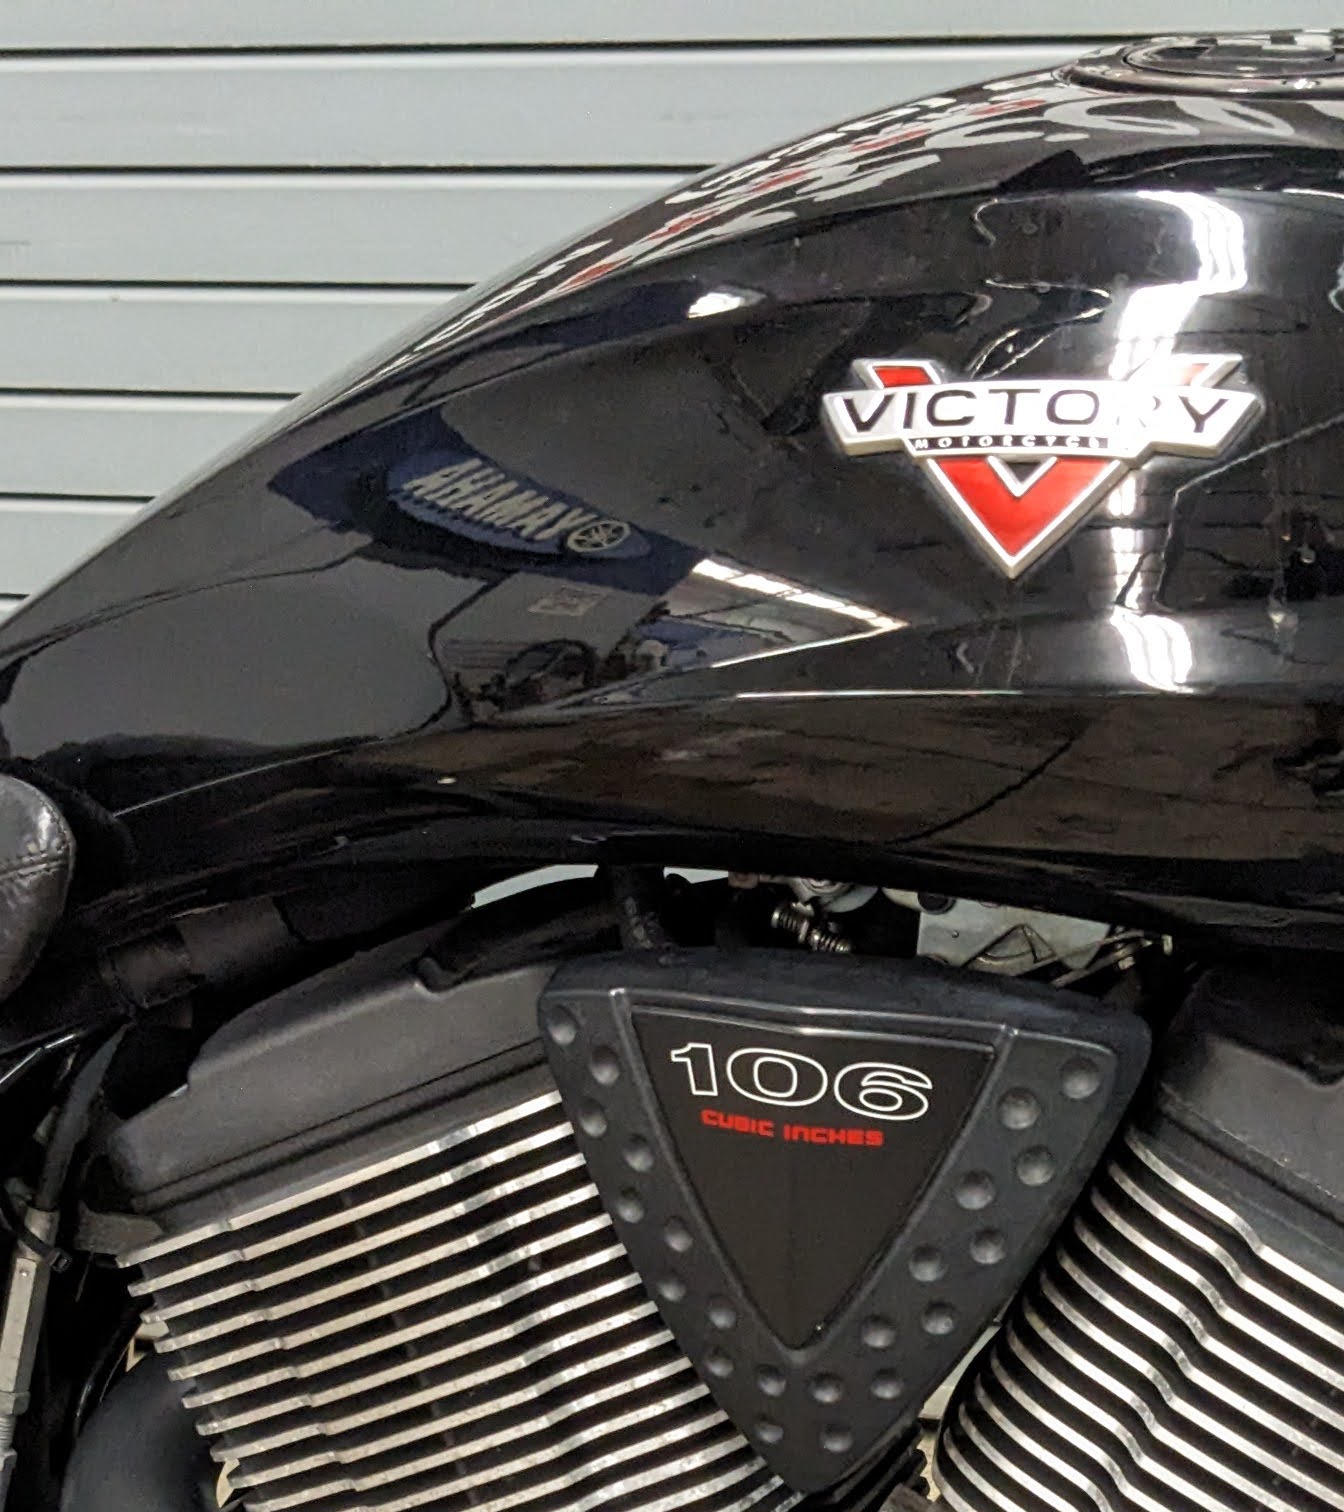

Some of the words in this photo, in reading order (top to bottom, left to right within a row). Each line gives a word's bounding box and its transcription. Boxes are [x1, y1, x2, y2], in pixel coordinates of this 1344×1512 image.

[843, 388, 1230, 433] VICTOY
[671, 1042, 933, 1120] 106
[701, 1109, 774, 1137] CUBIC
[783, 1124, 884, 1147] INCHES
